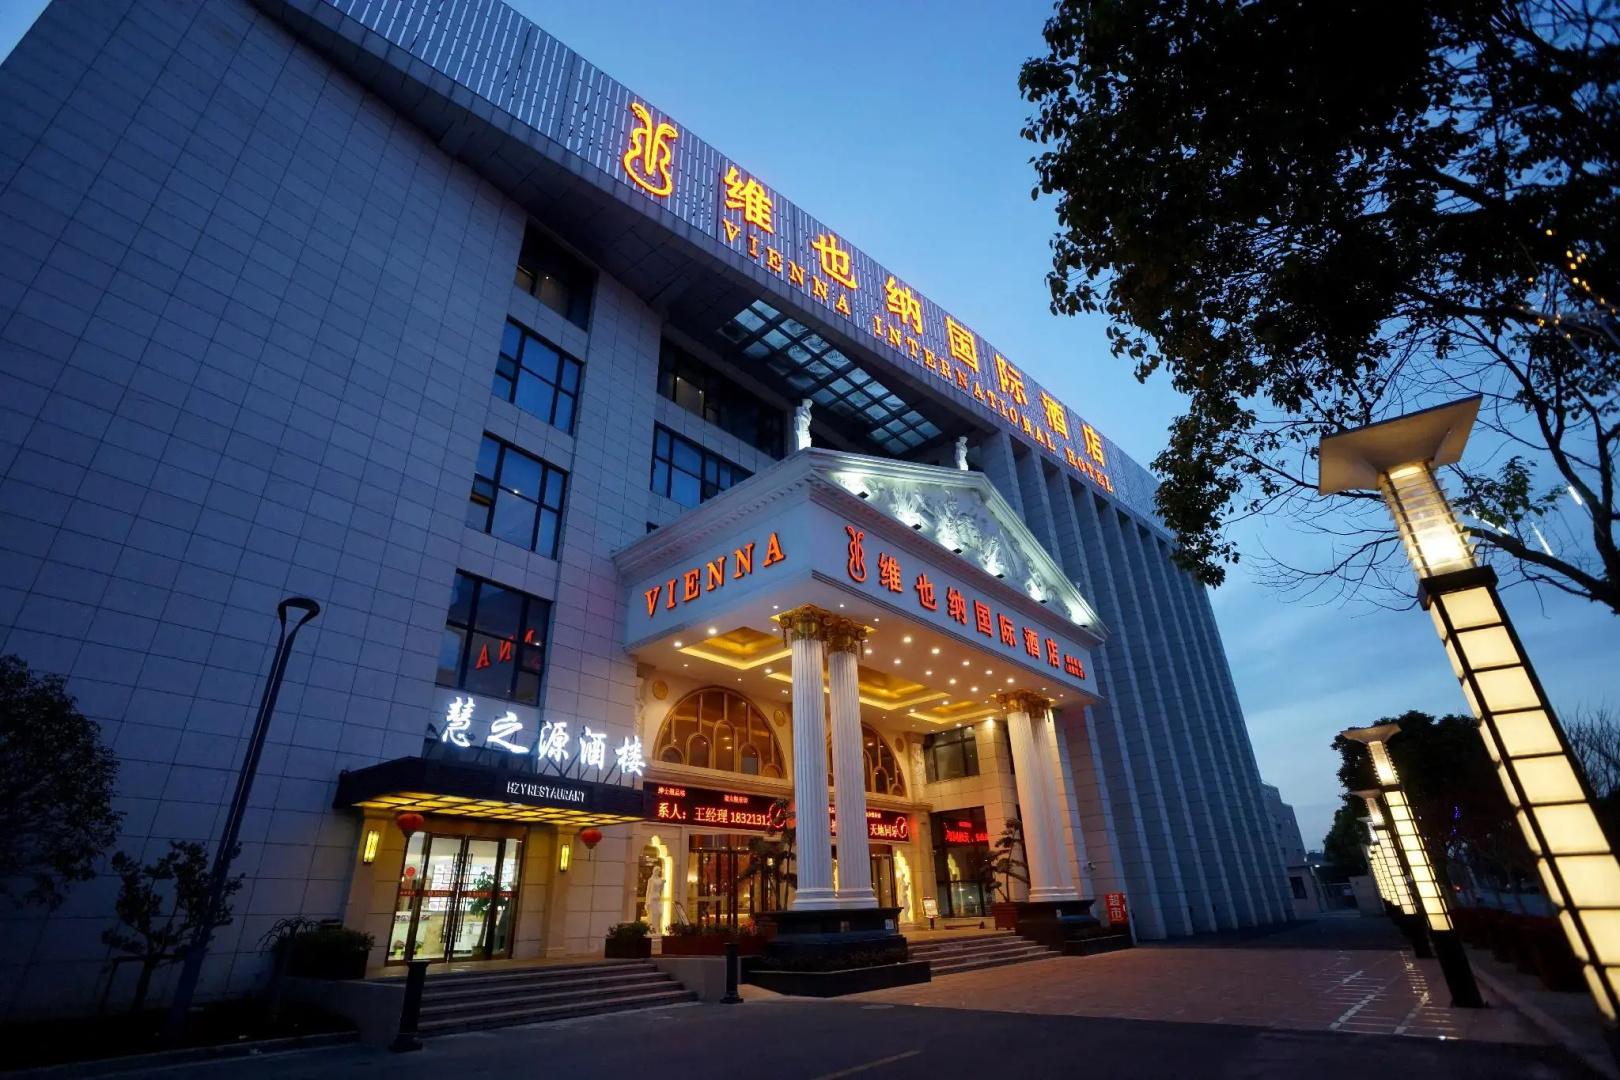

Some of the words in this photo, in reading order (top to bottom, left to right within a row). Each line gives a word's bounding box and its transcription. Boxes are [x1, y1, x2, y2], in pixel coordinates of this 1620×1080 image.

[722, 219, 851, 316] VIENNA
[873, 314, 1057, 453] INTERNATIONAL
[1064, 446, 1115, 493] HOTEL
[723, 165, 1106, 468] 维也纳国际酒店
[645, 531, 786, 616] VIENNA
[878, 552, 1061, 669] 维也纳国际酒店
[441, 696, 647, 777] 慧之源酒楼
[527, 783, 586, 803] RESTAURANT
[693, 806, 729, 824] 王经理
[1108, 893, 1122, 919] 超市
